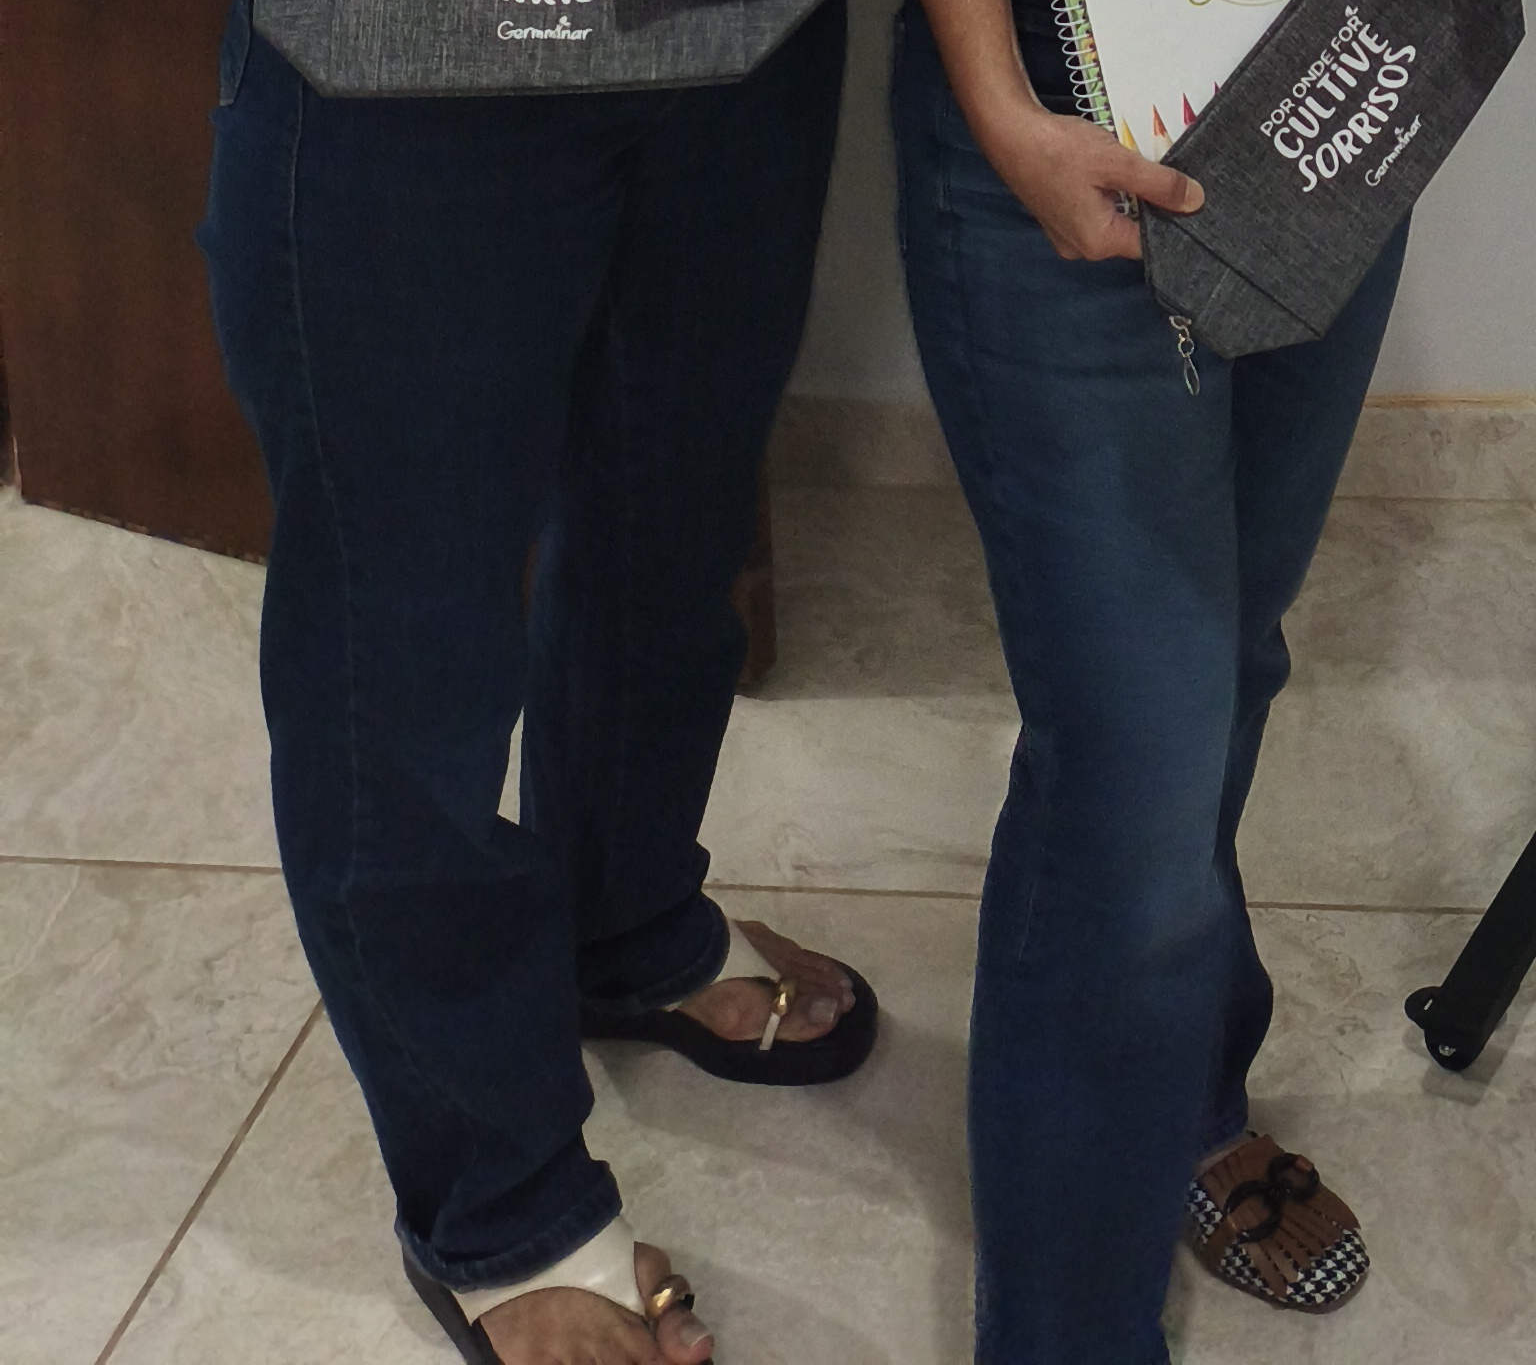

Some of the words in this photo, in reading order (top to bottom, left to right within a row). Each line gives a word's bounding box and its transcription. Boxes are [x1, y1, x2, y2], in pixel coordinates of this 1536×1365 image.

[1260, 97, 1295, 137] POR
[1292, 48, 1335, 98] ONDE
[1331, 15, 1363, 52] FOR
